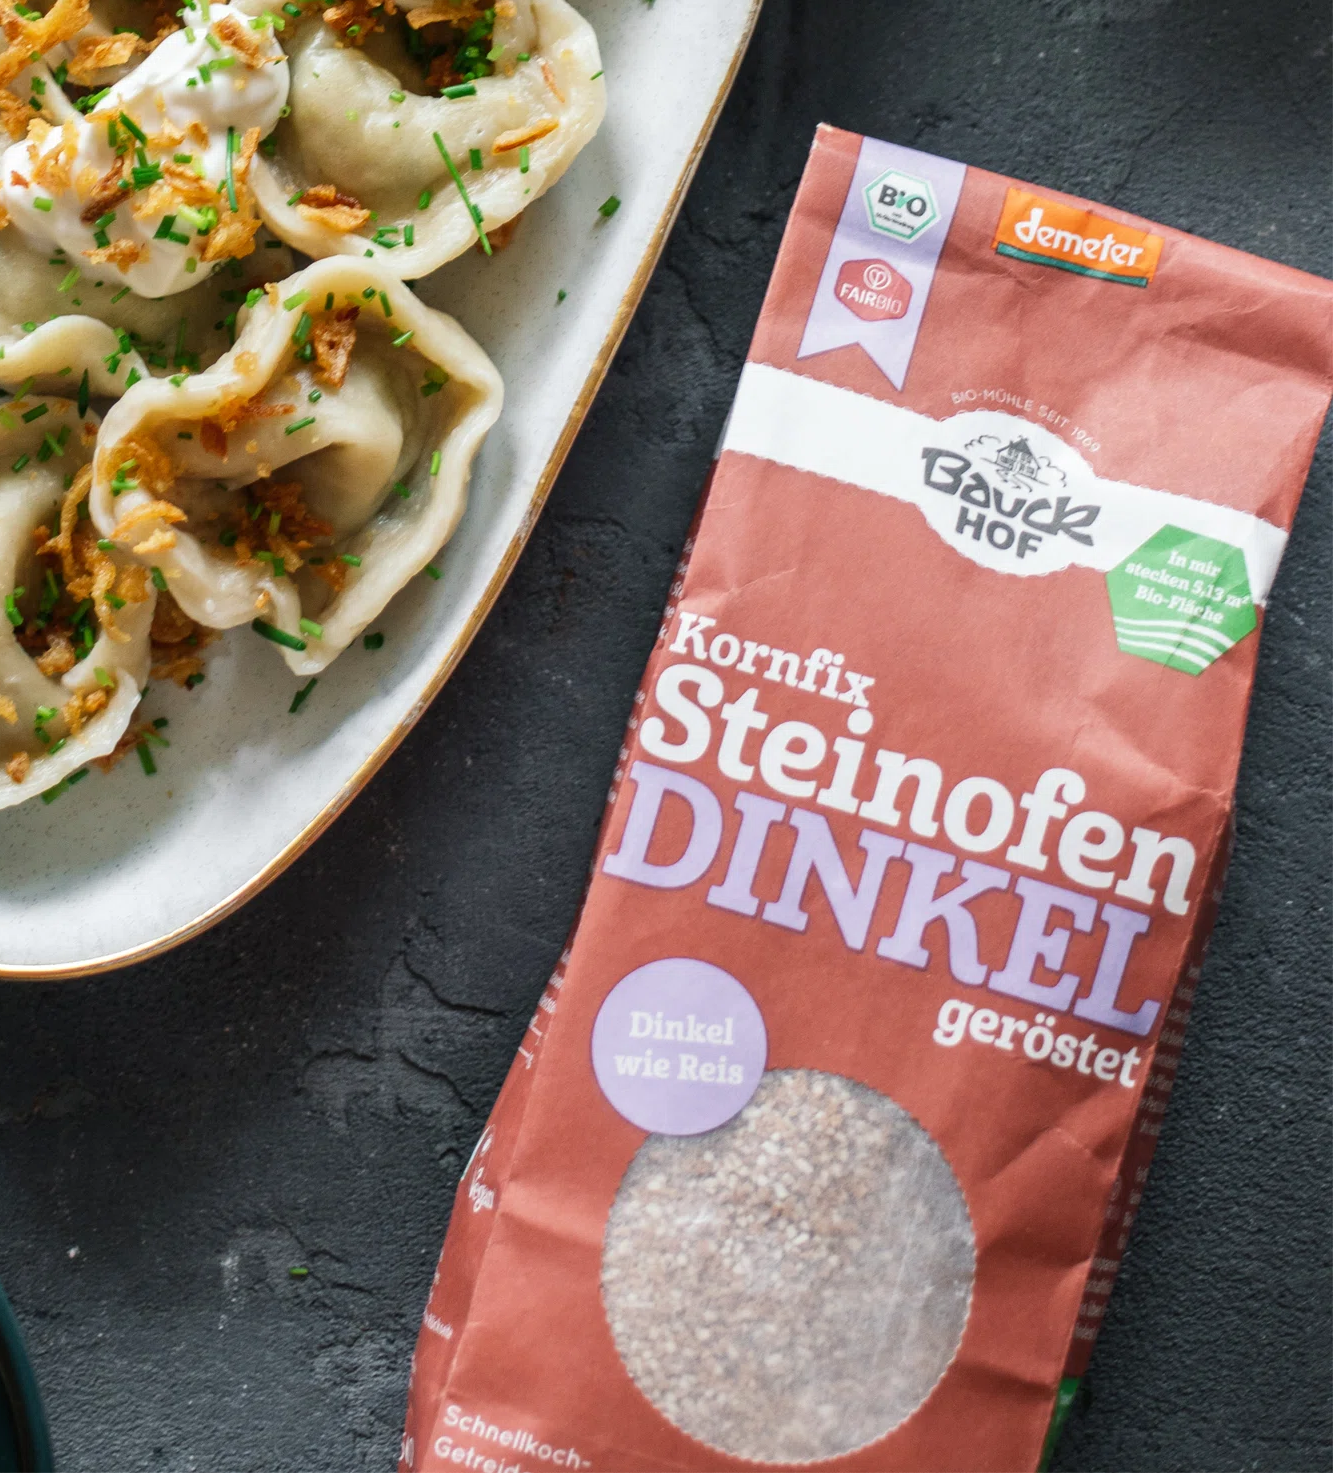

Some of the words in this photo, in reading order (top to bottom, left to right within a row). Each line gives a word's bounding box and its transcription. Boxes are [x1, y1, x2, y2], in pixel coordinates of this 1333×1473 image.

[1014, 207, 1144, 267] demeter
[839, 282, 903, 314] FAIRBIO
[950, 388, 1034, 412] BIO-MÜHLE
[1038, 404, 1070, 428] SEIT
[1070, 427, 1102, 453] 1969
[921, 447, 1102, 547] Bauck
[955, 506, 1043, 560] HOF
[1167, 549, 1187, 567] In
[1188, 558, 1222, 577] mir
[1124, 562, 1190, 592] stecken
[1191, 579, 1225, 603] 5,13
[1134, 584, 1224, 625] Bio-Fläche
[669, 611, 875, 709] Kornfix
[639, 663, 1198, 916] Steinofen
[602, 759, 1162, 1038] DINKEL
[628, 1010, 735, 1046] Dinkel
[933, 996, 1141, 1089] geröstet
[613, 1048, 670, 1079] wie
[676, 1053, 745, 1085] Reis
[443, 1404, 592, 1469] Schnellkoch-
